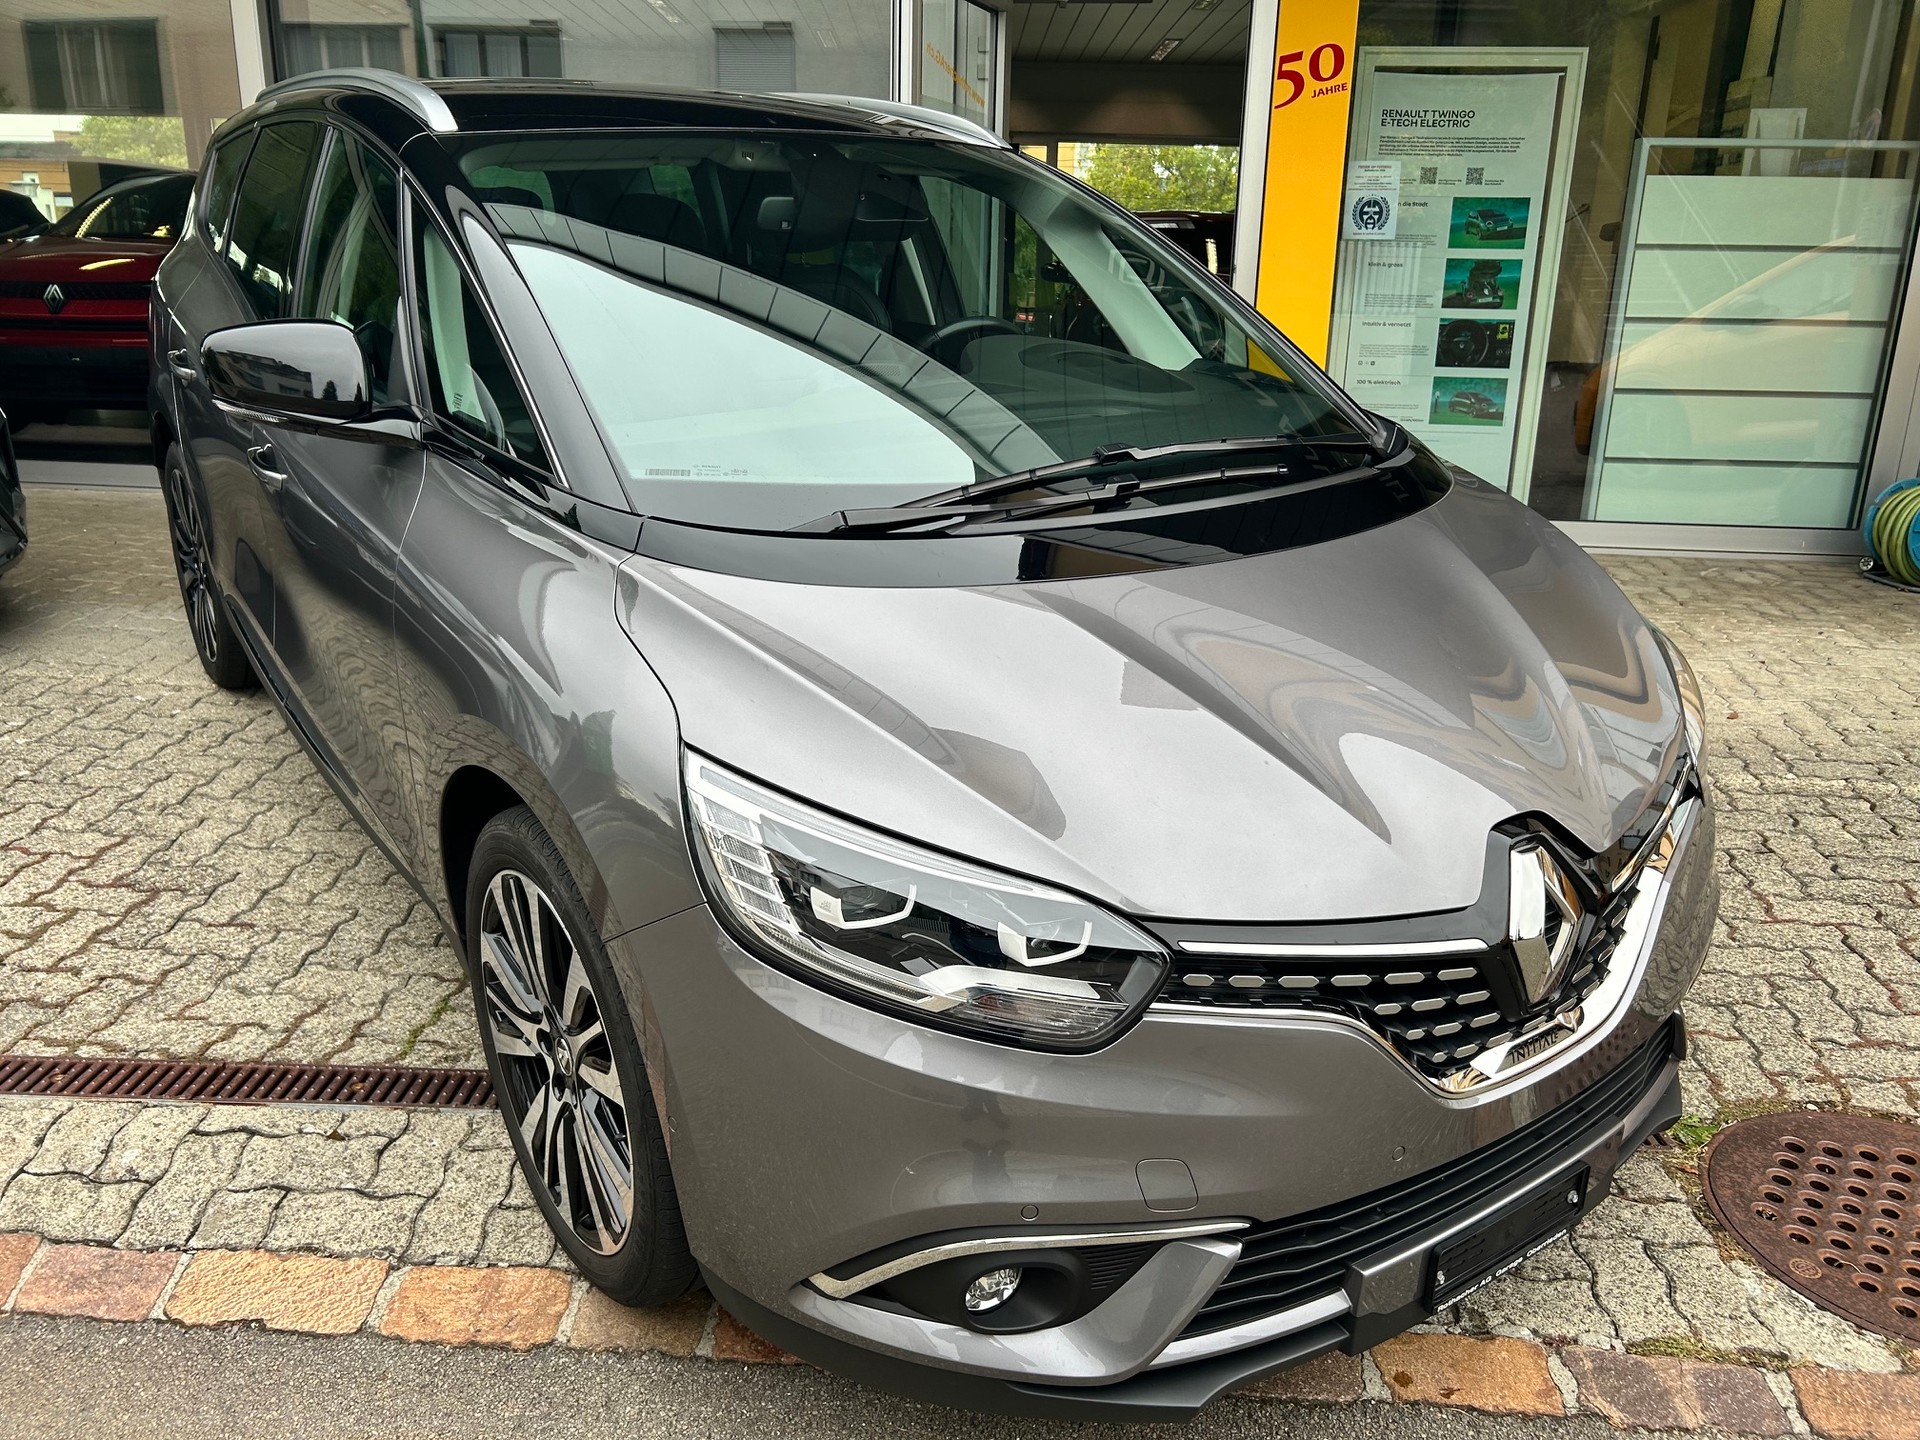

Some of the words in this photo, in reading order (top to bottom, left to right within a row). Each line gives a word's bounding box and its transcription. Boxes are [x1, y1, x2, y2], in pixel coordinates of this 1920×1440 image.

[1274, 43, 1345, 110] 50
[1311, 82, 1348, 99] JAHRE
[1381, 109, 1430, 118] RENAULT
[1431, 109, 1476, 119] TWINGO
[1380, 118, 1418, 127] E-TECH
[1420, 119, 1471, 128] ELECTRIC
[1479, 1275, 1493, 1288] AG
[1495, 1256, 1524, 1278] Garage
